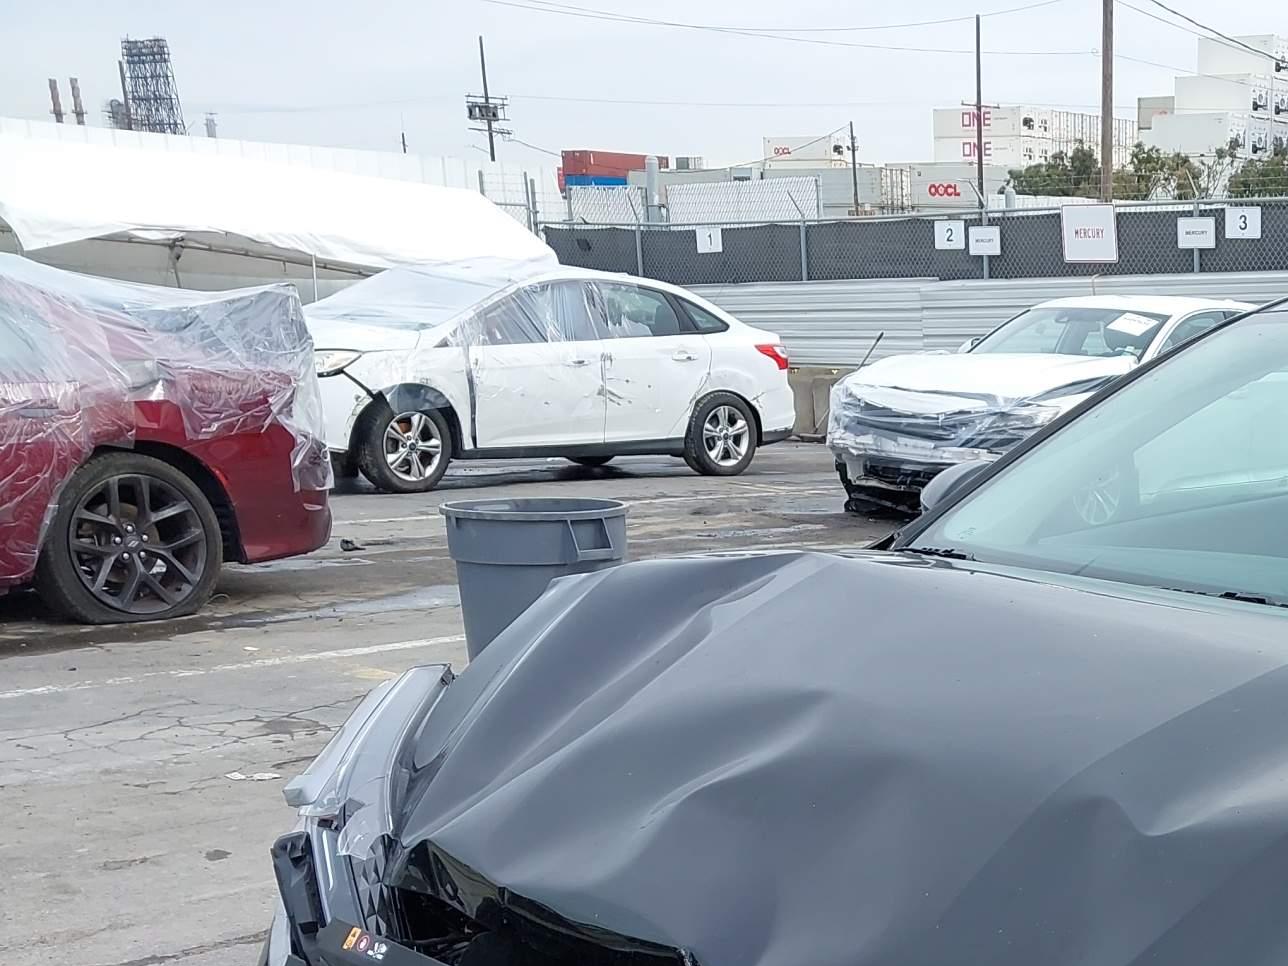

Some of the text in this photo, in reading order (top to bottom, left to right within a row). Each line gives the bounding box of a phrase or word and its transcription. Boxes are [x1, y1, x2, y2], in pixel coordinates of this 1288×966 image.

[1238, 214, 1248, 231] 3
[707, 232, 713, 246] 1
[946, 228, 954, 242] 2
[1074, 227, 1104, 239] MERCURY
